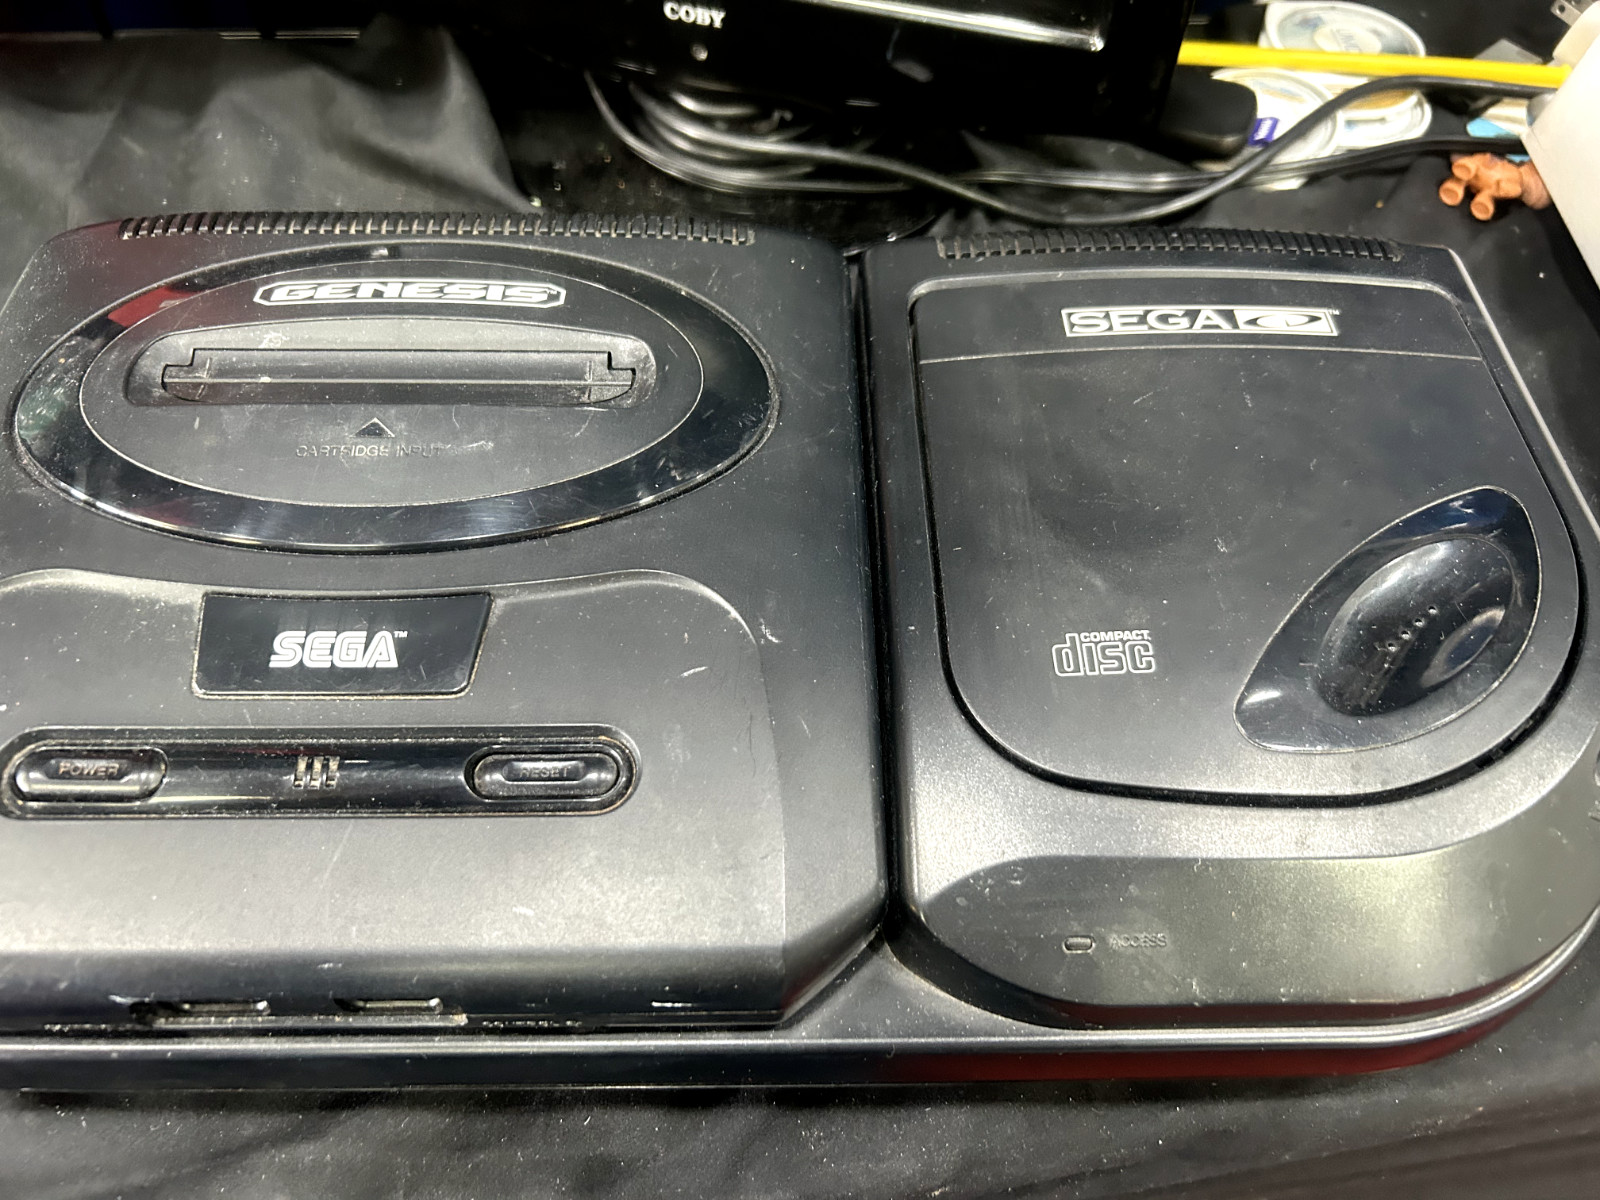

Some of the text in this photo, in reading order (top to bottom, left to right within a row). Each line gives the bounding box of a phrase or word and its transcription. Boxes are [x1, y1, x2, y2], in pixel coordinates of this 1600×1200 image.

[662, 2, 726, 29] COBY
[271, 282, 549, 302] GENESIS
[1069, 308, 1235, 333] SEGA
[296, 443, 448, 458] CARTRIDGE INPUT
[1080, 629, 1150, 642] COMPACT
[269, 630, 399, 668] SEGA
[1051, 632, 1156, 676] disc
[58, 762, 120, 776] POWER
[518, 766, 572, 778] RESET
[1109, 933, 1167, 948] ACCESS
